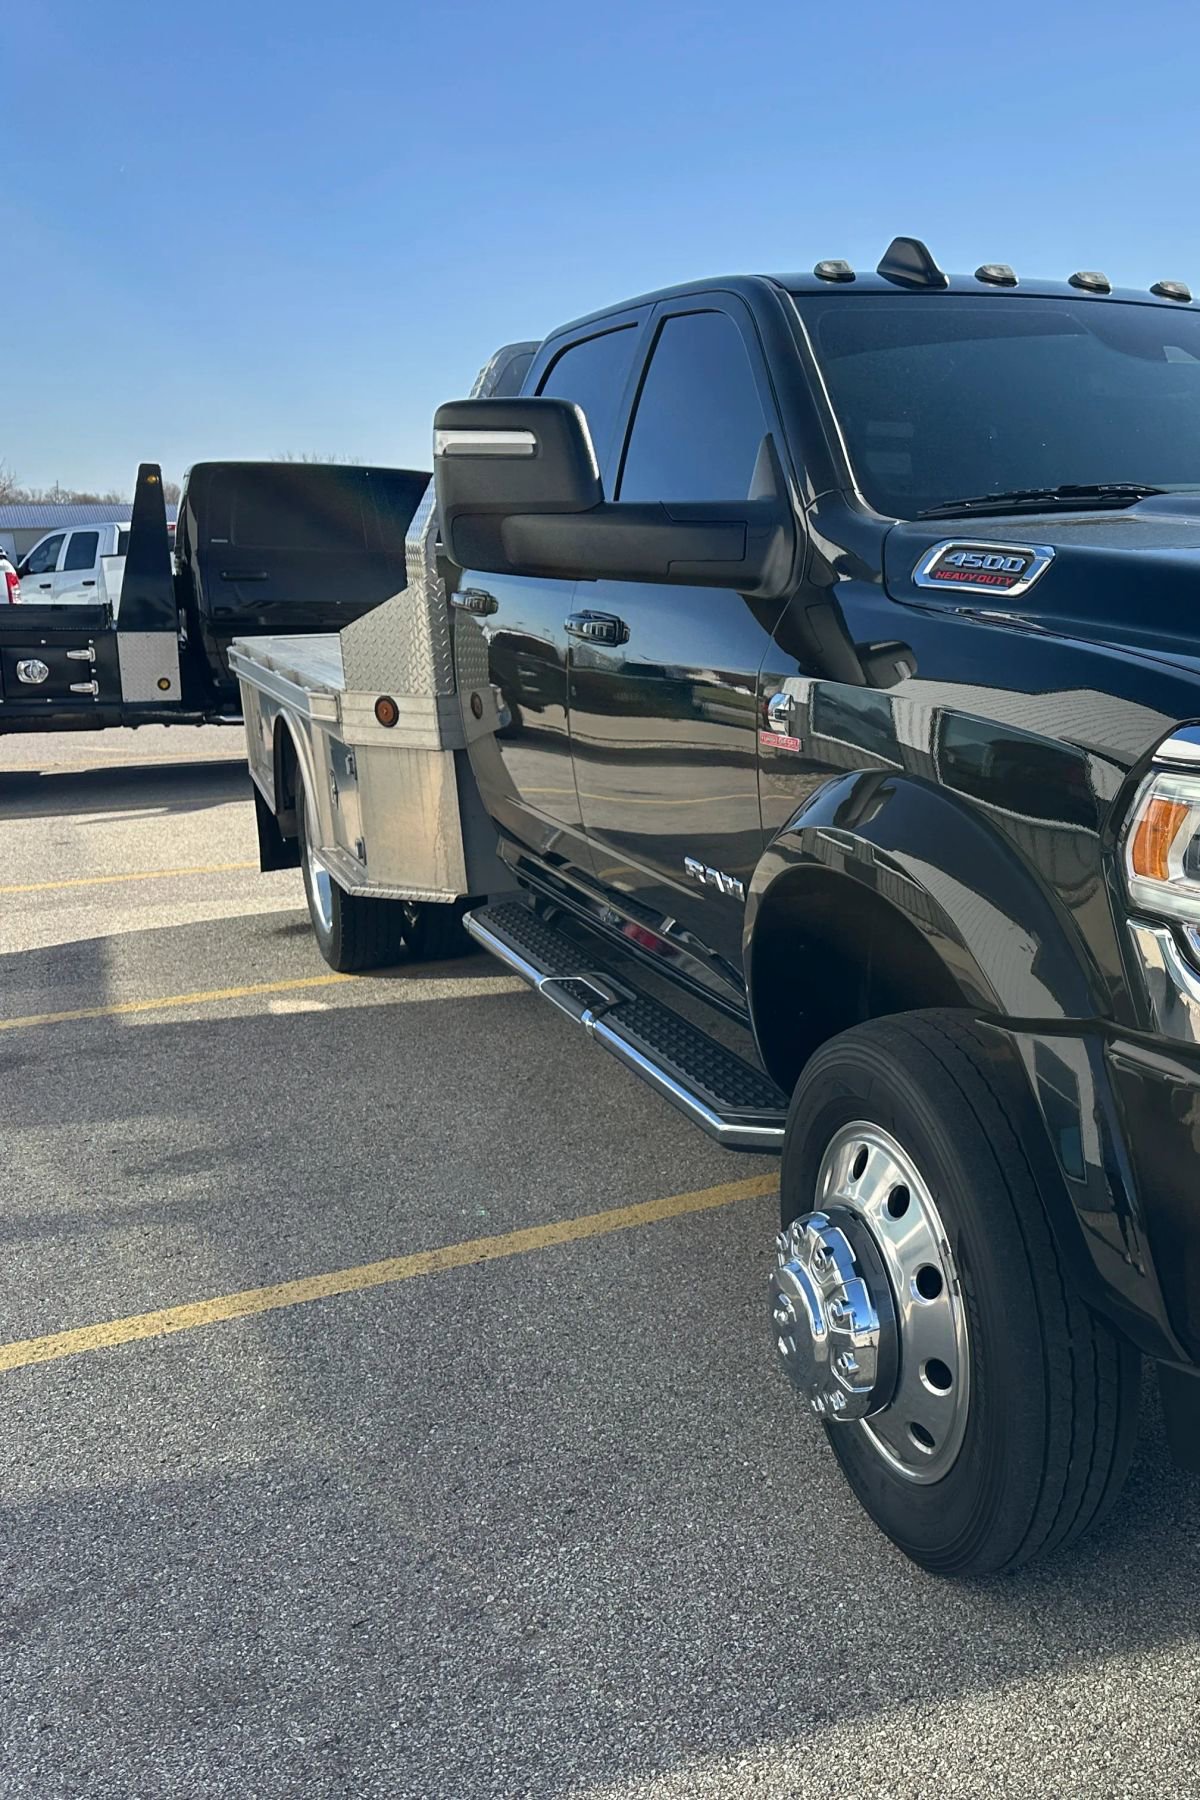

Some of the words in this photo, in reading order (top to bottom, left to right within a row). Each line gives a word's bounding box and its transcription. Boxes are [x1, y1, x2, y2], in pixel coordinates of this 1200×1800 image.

[944, 551, 1026, 573] 4500
[935, 570, 975, 583] HEAVY
[976, 574, 1015, 586] DUTY
